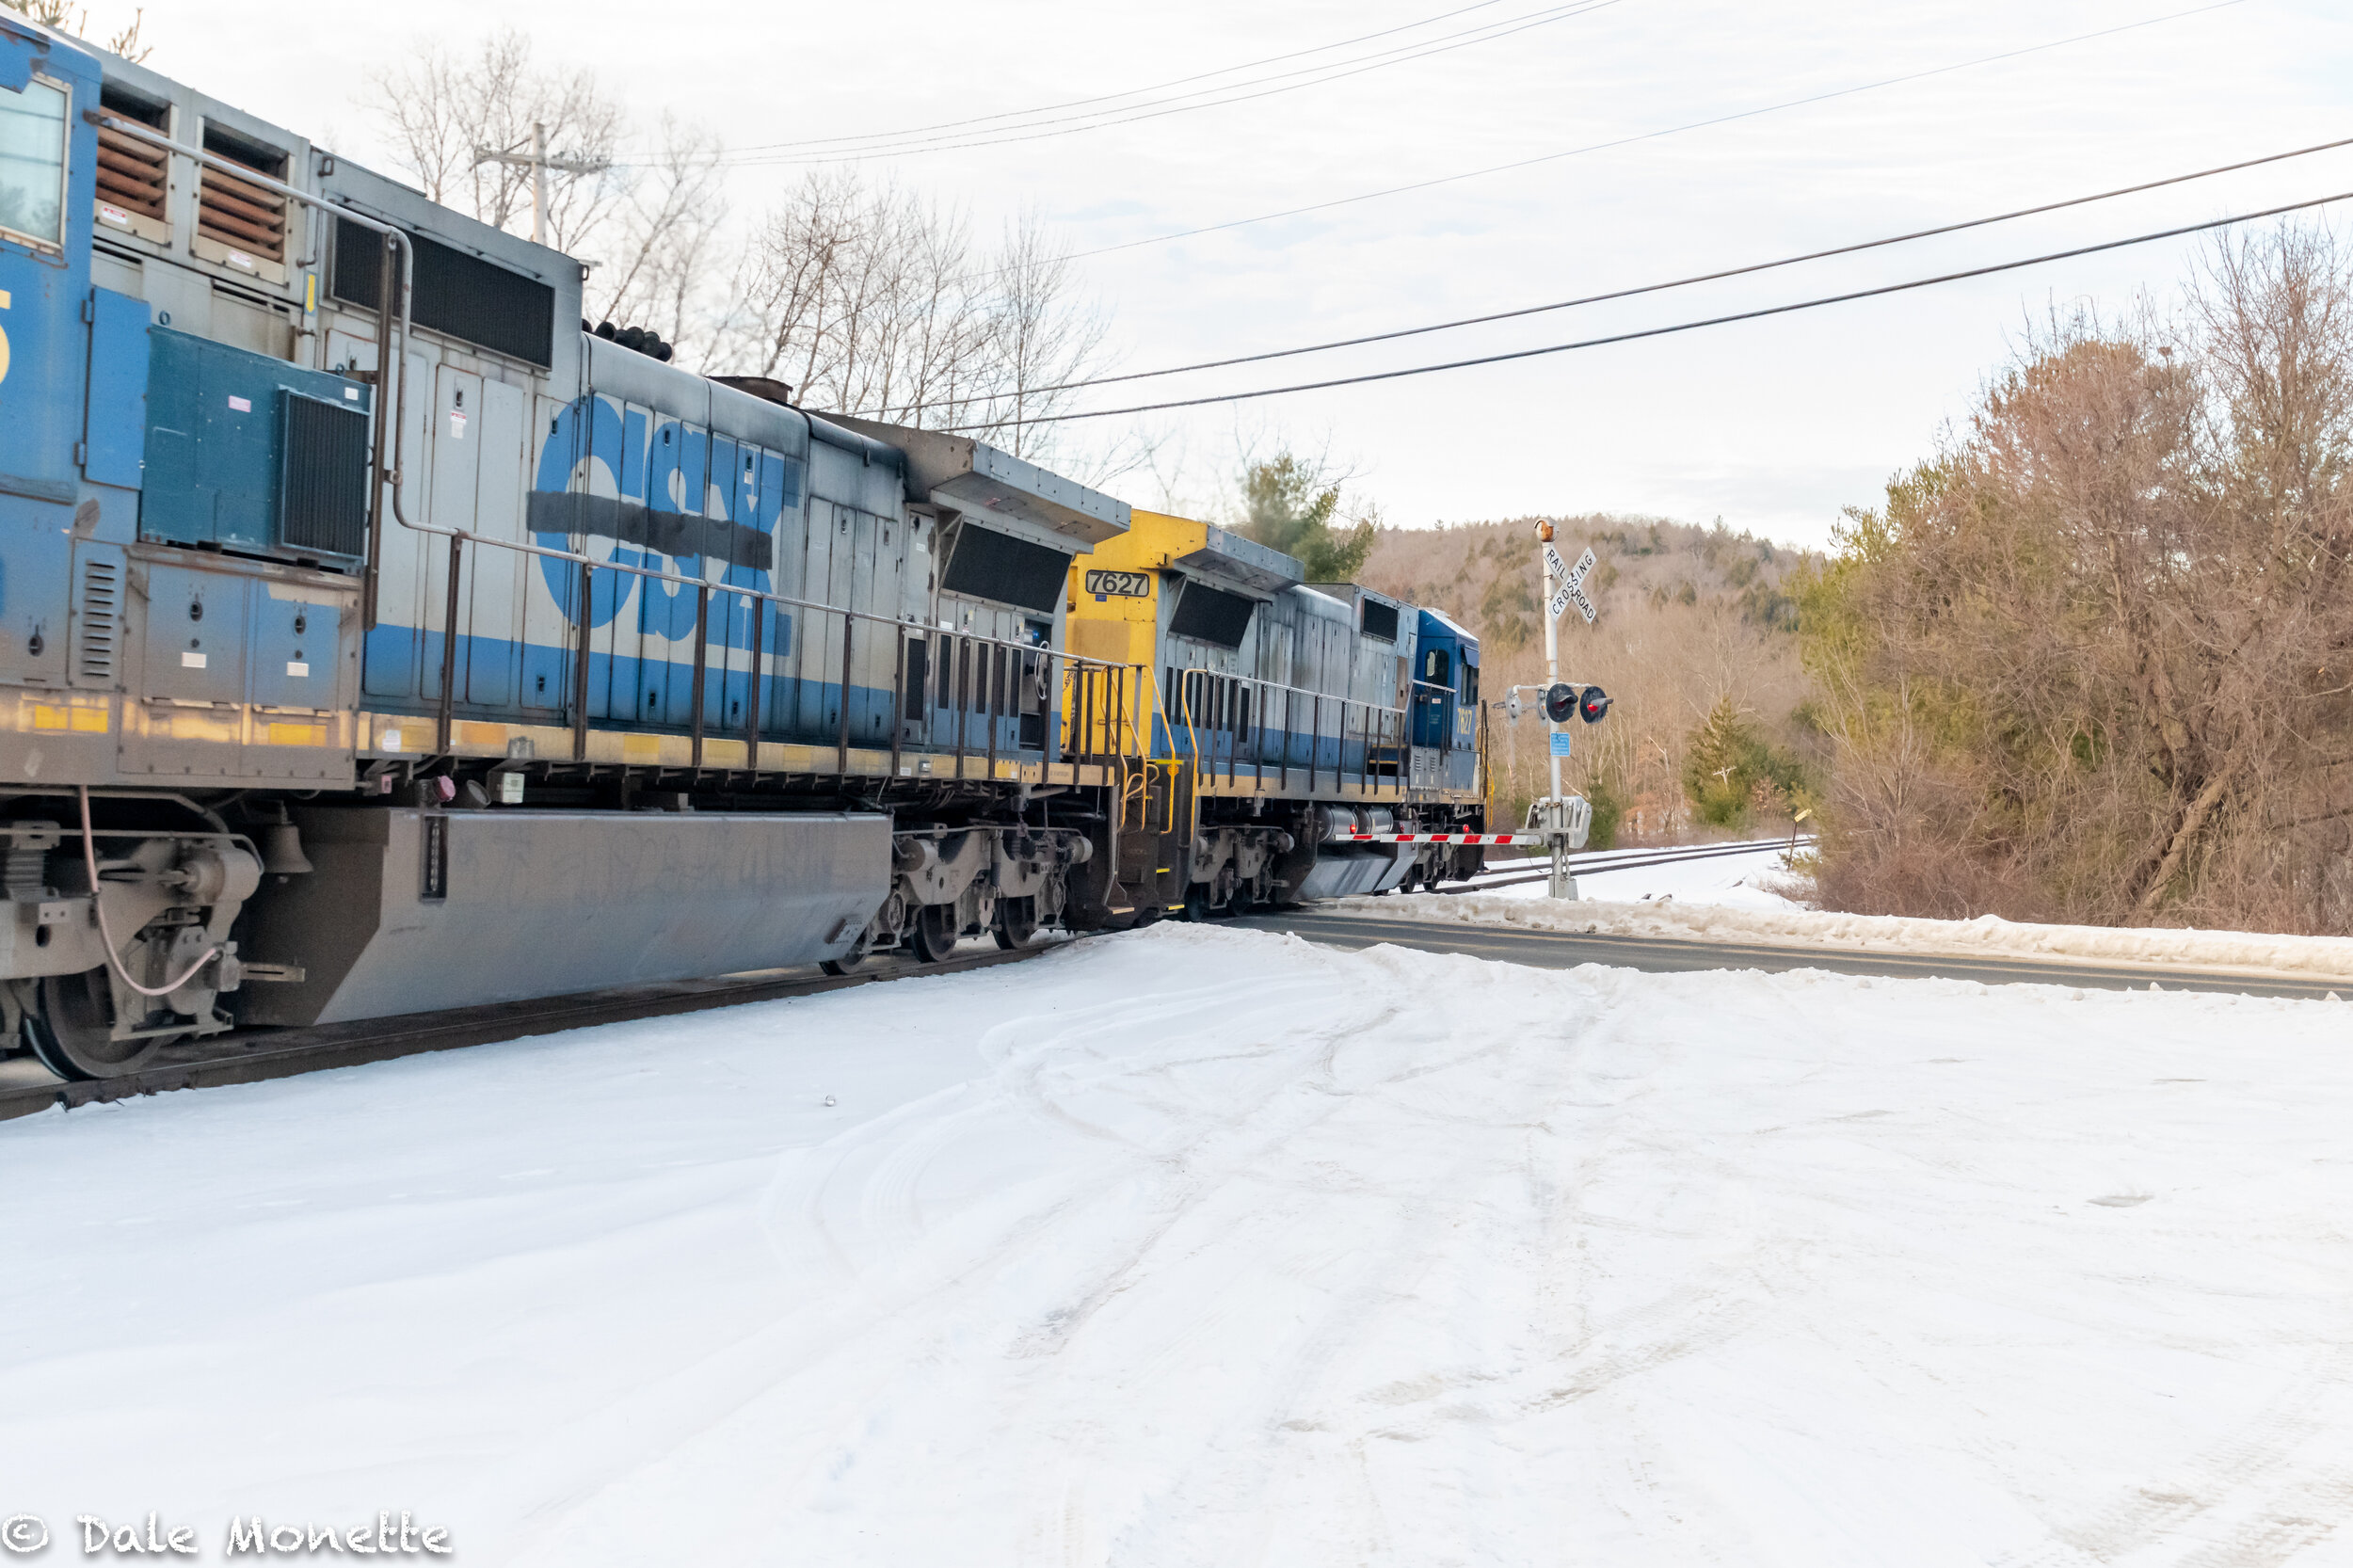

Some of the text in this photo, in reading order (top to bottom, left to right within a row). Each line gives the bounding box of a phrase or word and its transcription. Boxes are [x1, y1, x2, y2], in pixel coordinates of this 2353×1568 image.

[535, 395, 800, 657] CSX
[1089, 571, 1146, 595] 7627
[1546, 549, 1594, 619] RAIL ROAD
[1552, 554, 1593, 615] CROSSING
[1457, 707, 1473, 735] 7627
